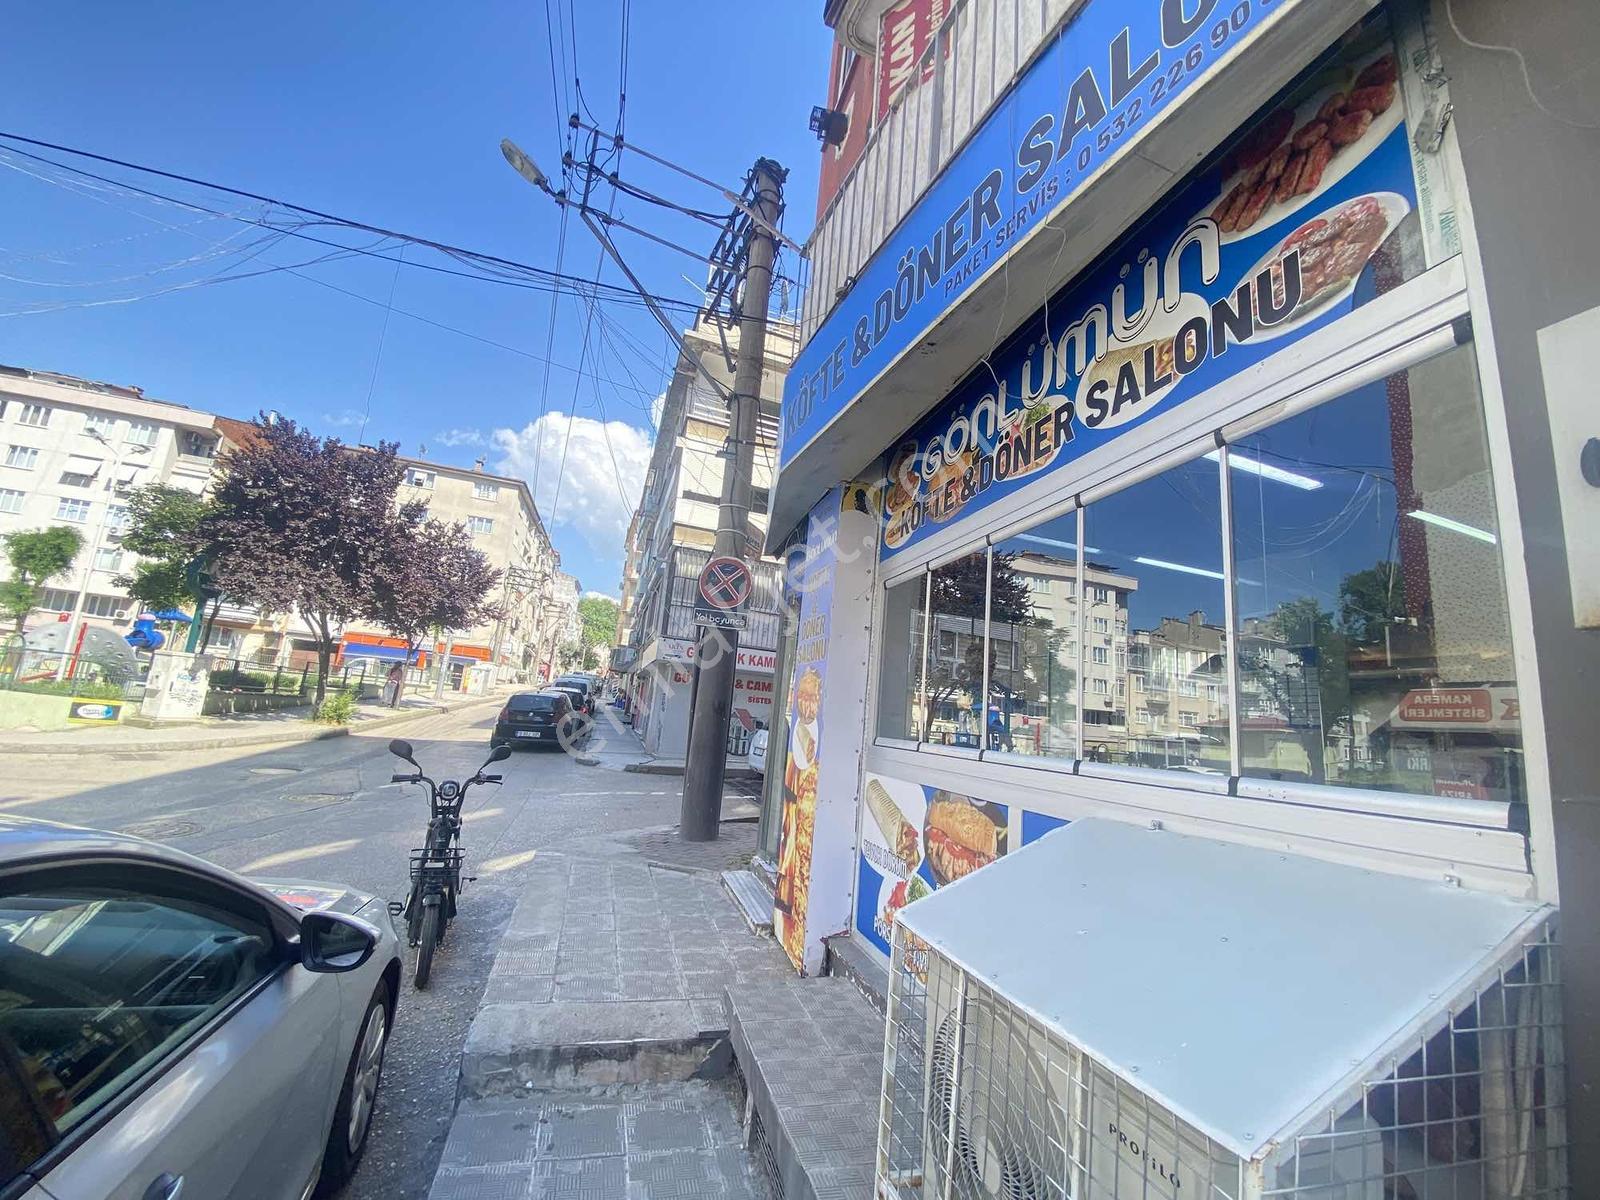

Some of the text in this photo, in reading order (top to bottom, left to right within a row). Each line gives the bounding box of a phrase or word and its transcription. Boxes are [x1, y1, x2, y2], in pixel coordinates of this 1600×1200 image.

[944, 241, 991, 298] PAKET
[995, 175, 1059, 248] SERVİS
[1077, 144, 1092, 173] 0
[1097, 97, 1143, 153] 532
[1150, 42, 1204, 107] 226
[1210, 0, 1251, 50] 90
[784, 336, 848, 439] KÖFTE
[900, 477, 956, 538] KÖFTE
[1085, 249, 1302, 428] SALONU
